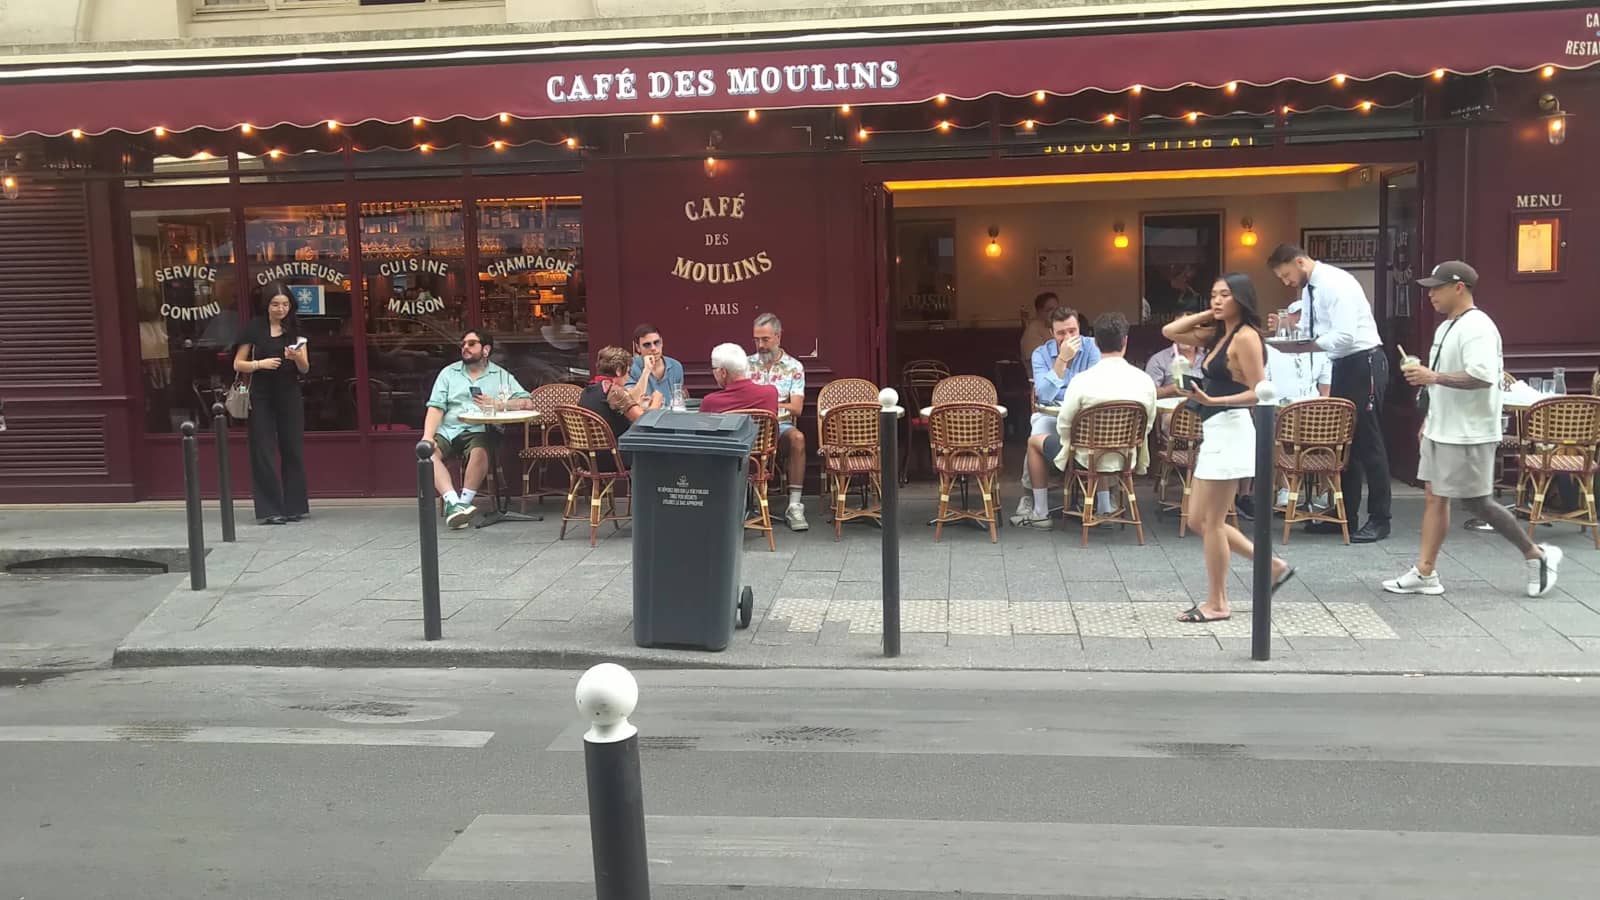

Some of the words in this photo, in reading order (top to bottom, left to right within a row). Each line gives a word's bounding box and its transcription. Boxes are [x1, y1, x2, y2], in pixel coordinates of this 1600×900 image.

[546, 67, 637, 103] CAFÉ
[647, 69, 717, 99] DES
[726, 60, 901, 96] MOULINS
[685, 192, 746, 221] CAFÉ
[1516, 194, 1563, 208] MENU
[705, 233, 729, 246] DES
[155, 265, 217, 282] SERVICE
[256, 261, 345, 287] CHARTREUSE
[380, 258, 449, 278] CUISINE
[487, 255, 576, 278] CHAMPAGNE
[671, 251, 773, 284] MOULINS
[160, 301, 221, 321] CONTINU
[387, 296, 446, 315] MAISON
[704, 302, 740, 316] PARIS
